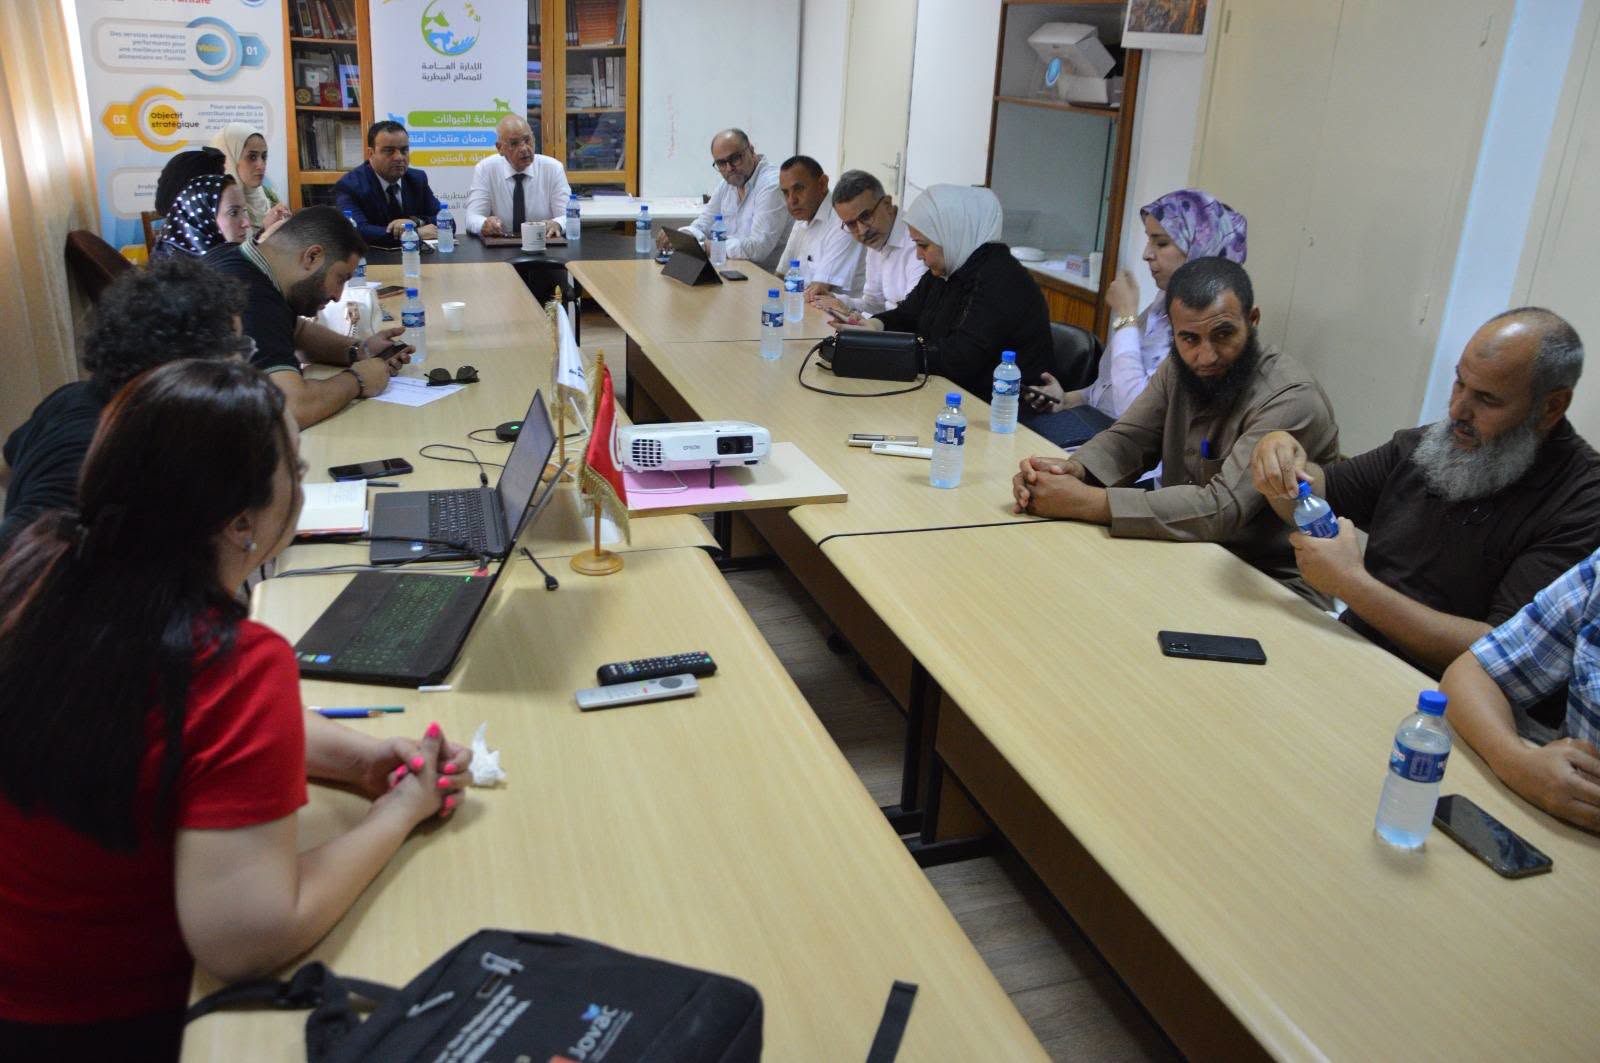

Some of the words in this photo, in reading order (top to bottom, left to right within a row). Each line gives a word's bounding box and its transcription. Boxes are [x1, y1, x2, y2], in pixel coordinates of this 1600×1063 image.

[246, 46, 258, 55] 01
[113, 115, 126, 124] 02
[151, 112, 183, 120] Objectif
[433, 113, 472, 125] الحيوانات
[473, 114, 497, 127] حماية
[151, 120, 200, 129] stratégique
[461, 132, 488, 144] ضمان
